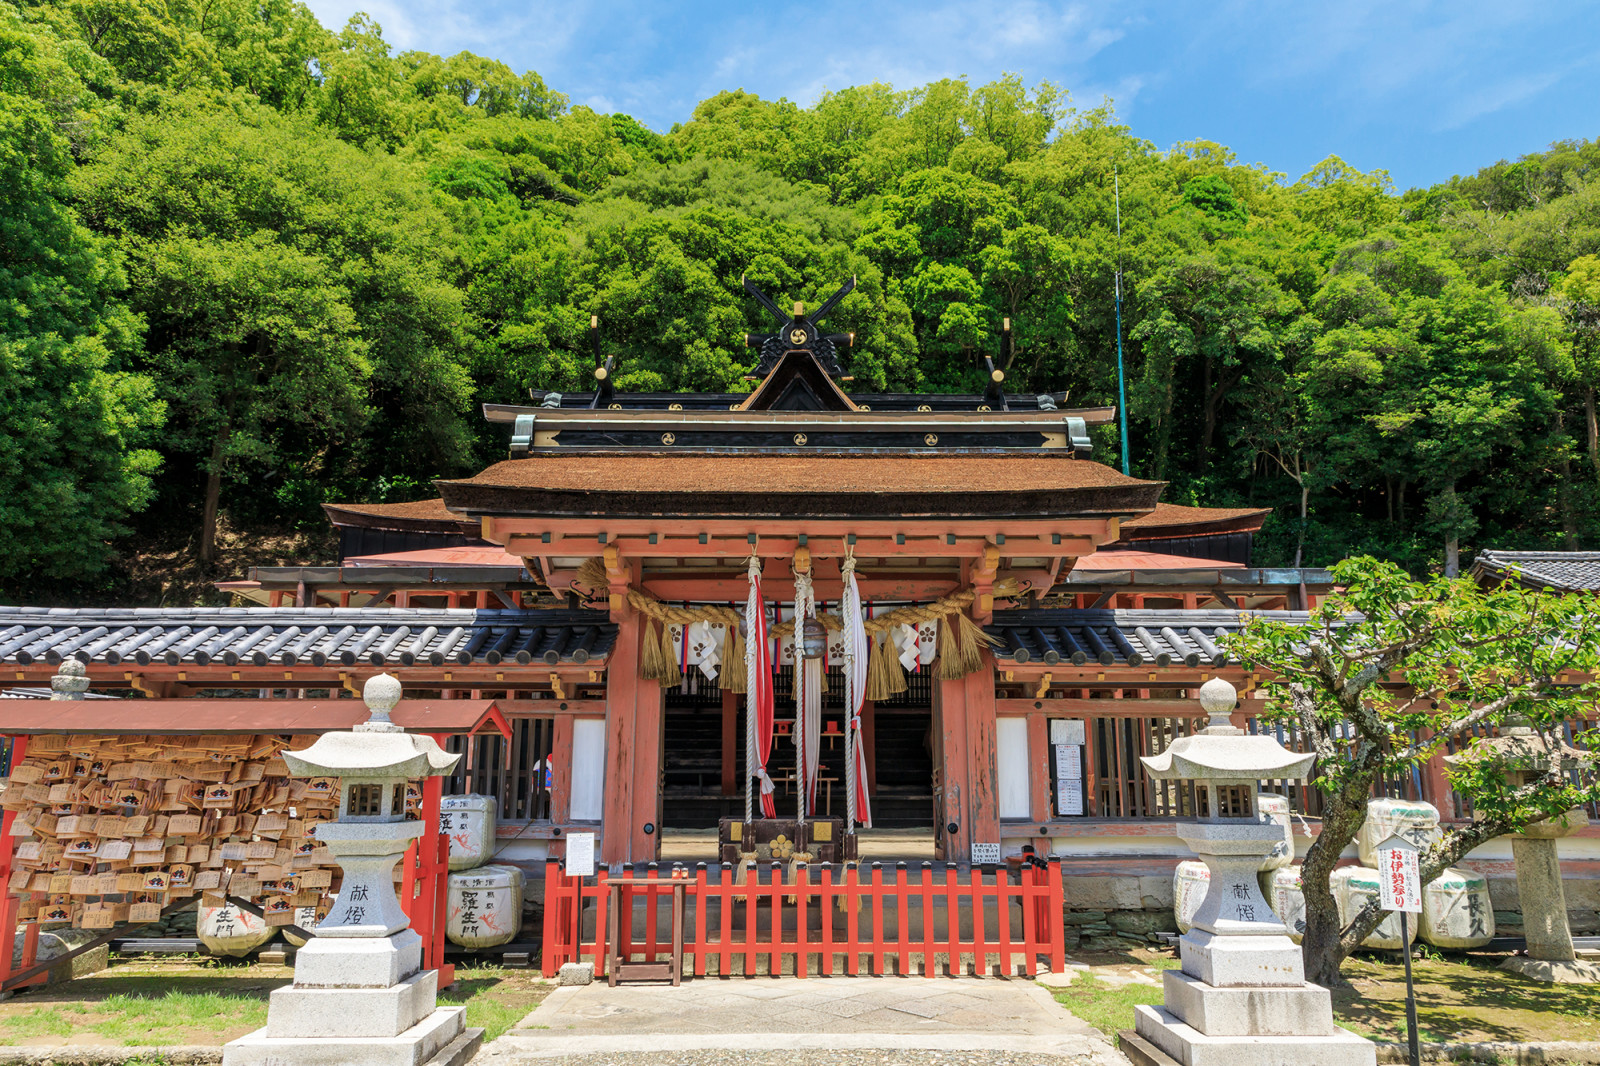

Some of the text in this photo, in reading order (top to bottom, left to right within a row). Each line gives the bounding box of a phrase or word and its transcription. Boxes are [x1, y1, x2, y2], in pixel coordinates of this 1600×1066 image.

[1390, 849, 1405, 908] お伊勢参り
[460, 890, 480, 938] 羅生門
[1461, 893, 1487, 938] 長久
